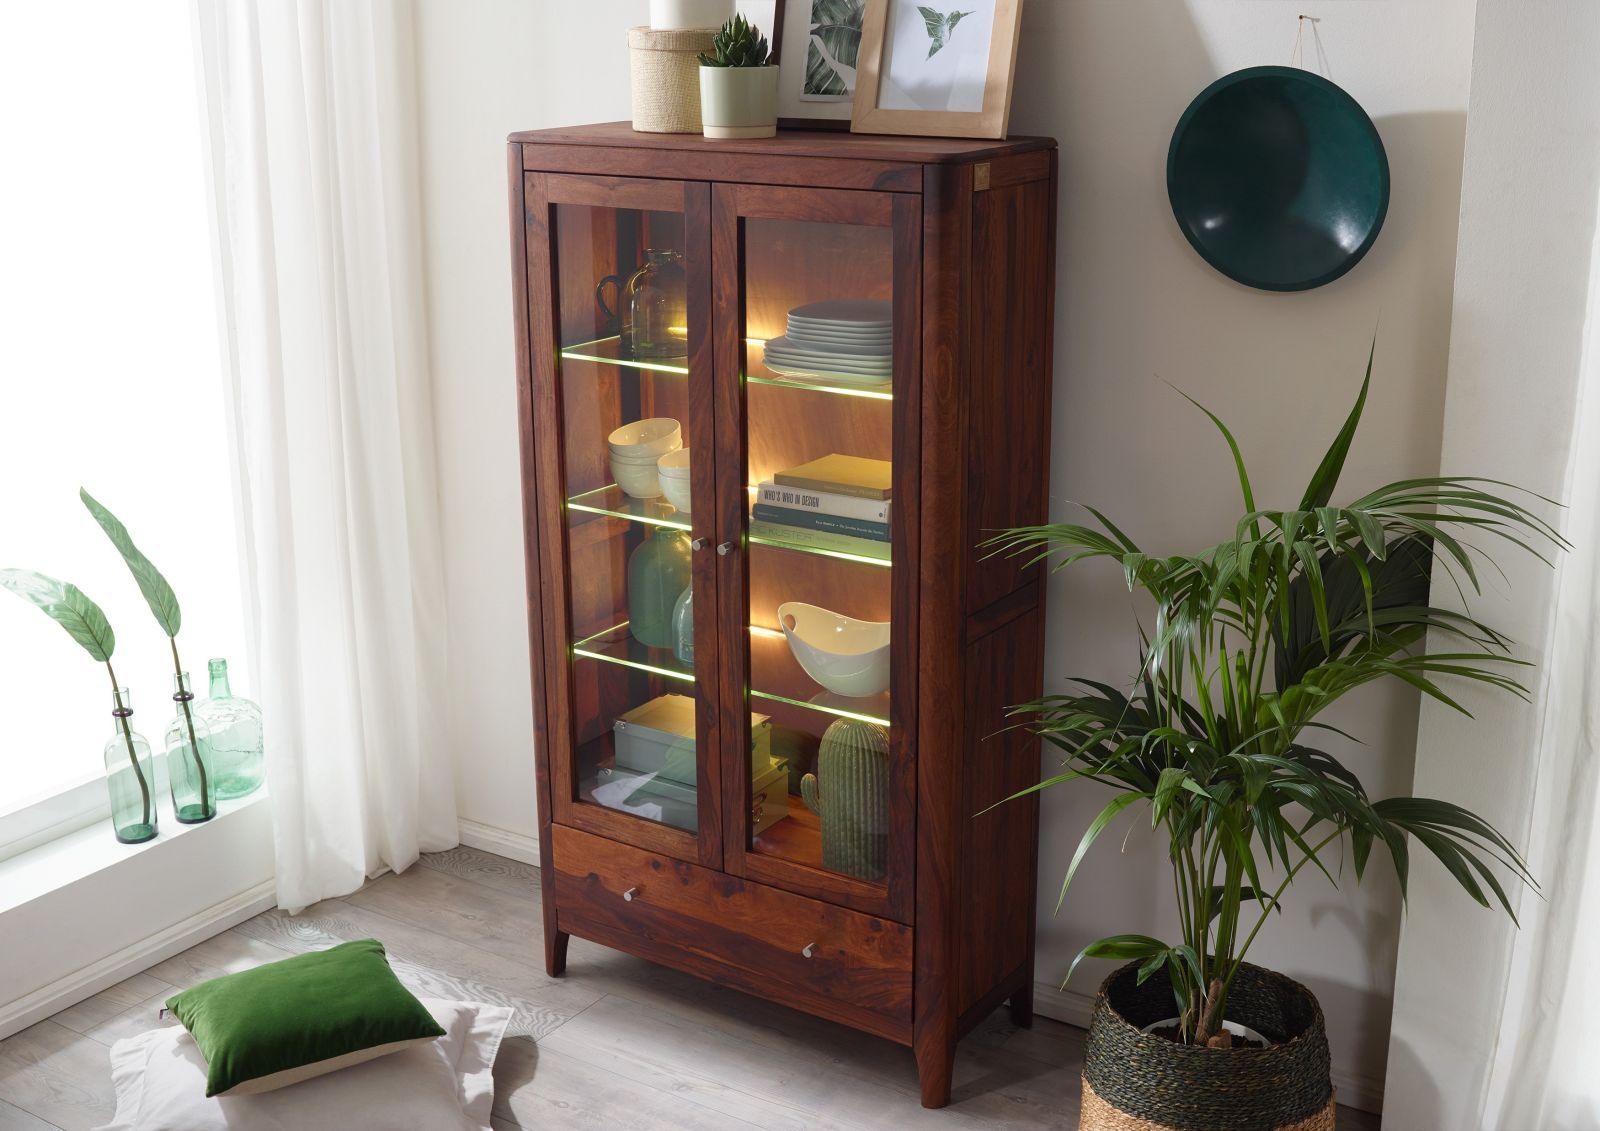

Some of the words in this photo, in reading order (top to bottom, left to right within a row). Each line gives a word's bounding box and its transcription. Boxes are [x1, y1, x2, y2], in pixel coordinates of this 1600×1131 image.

[764, 490, 780, 502] WHO'S
[782, 492, 793, 503] WHO
[795, 494, 801, 505] IN
[802, 495, 820, 508] DESIGN
